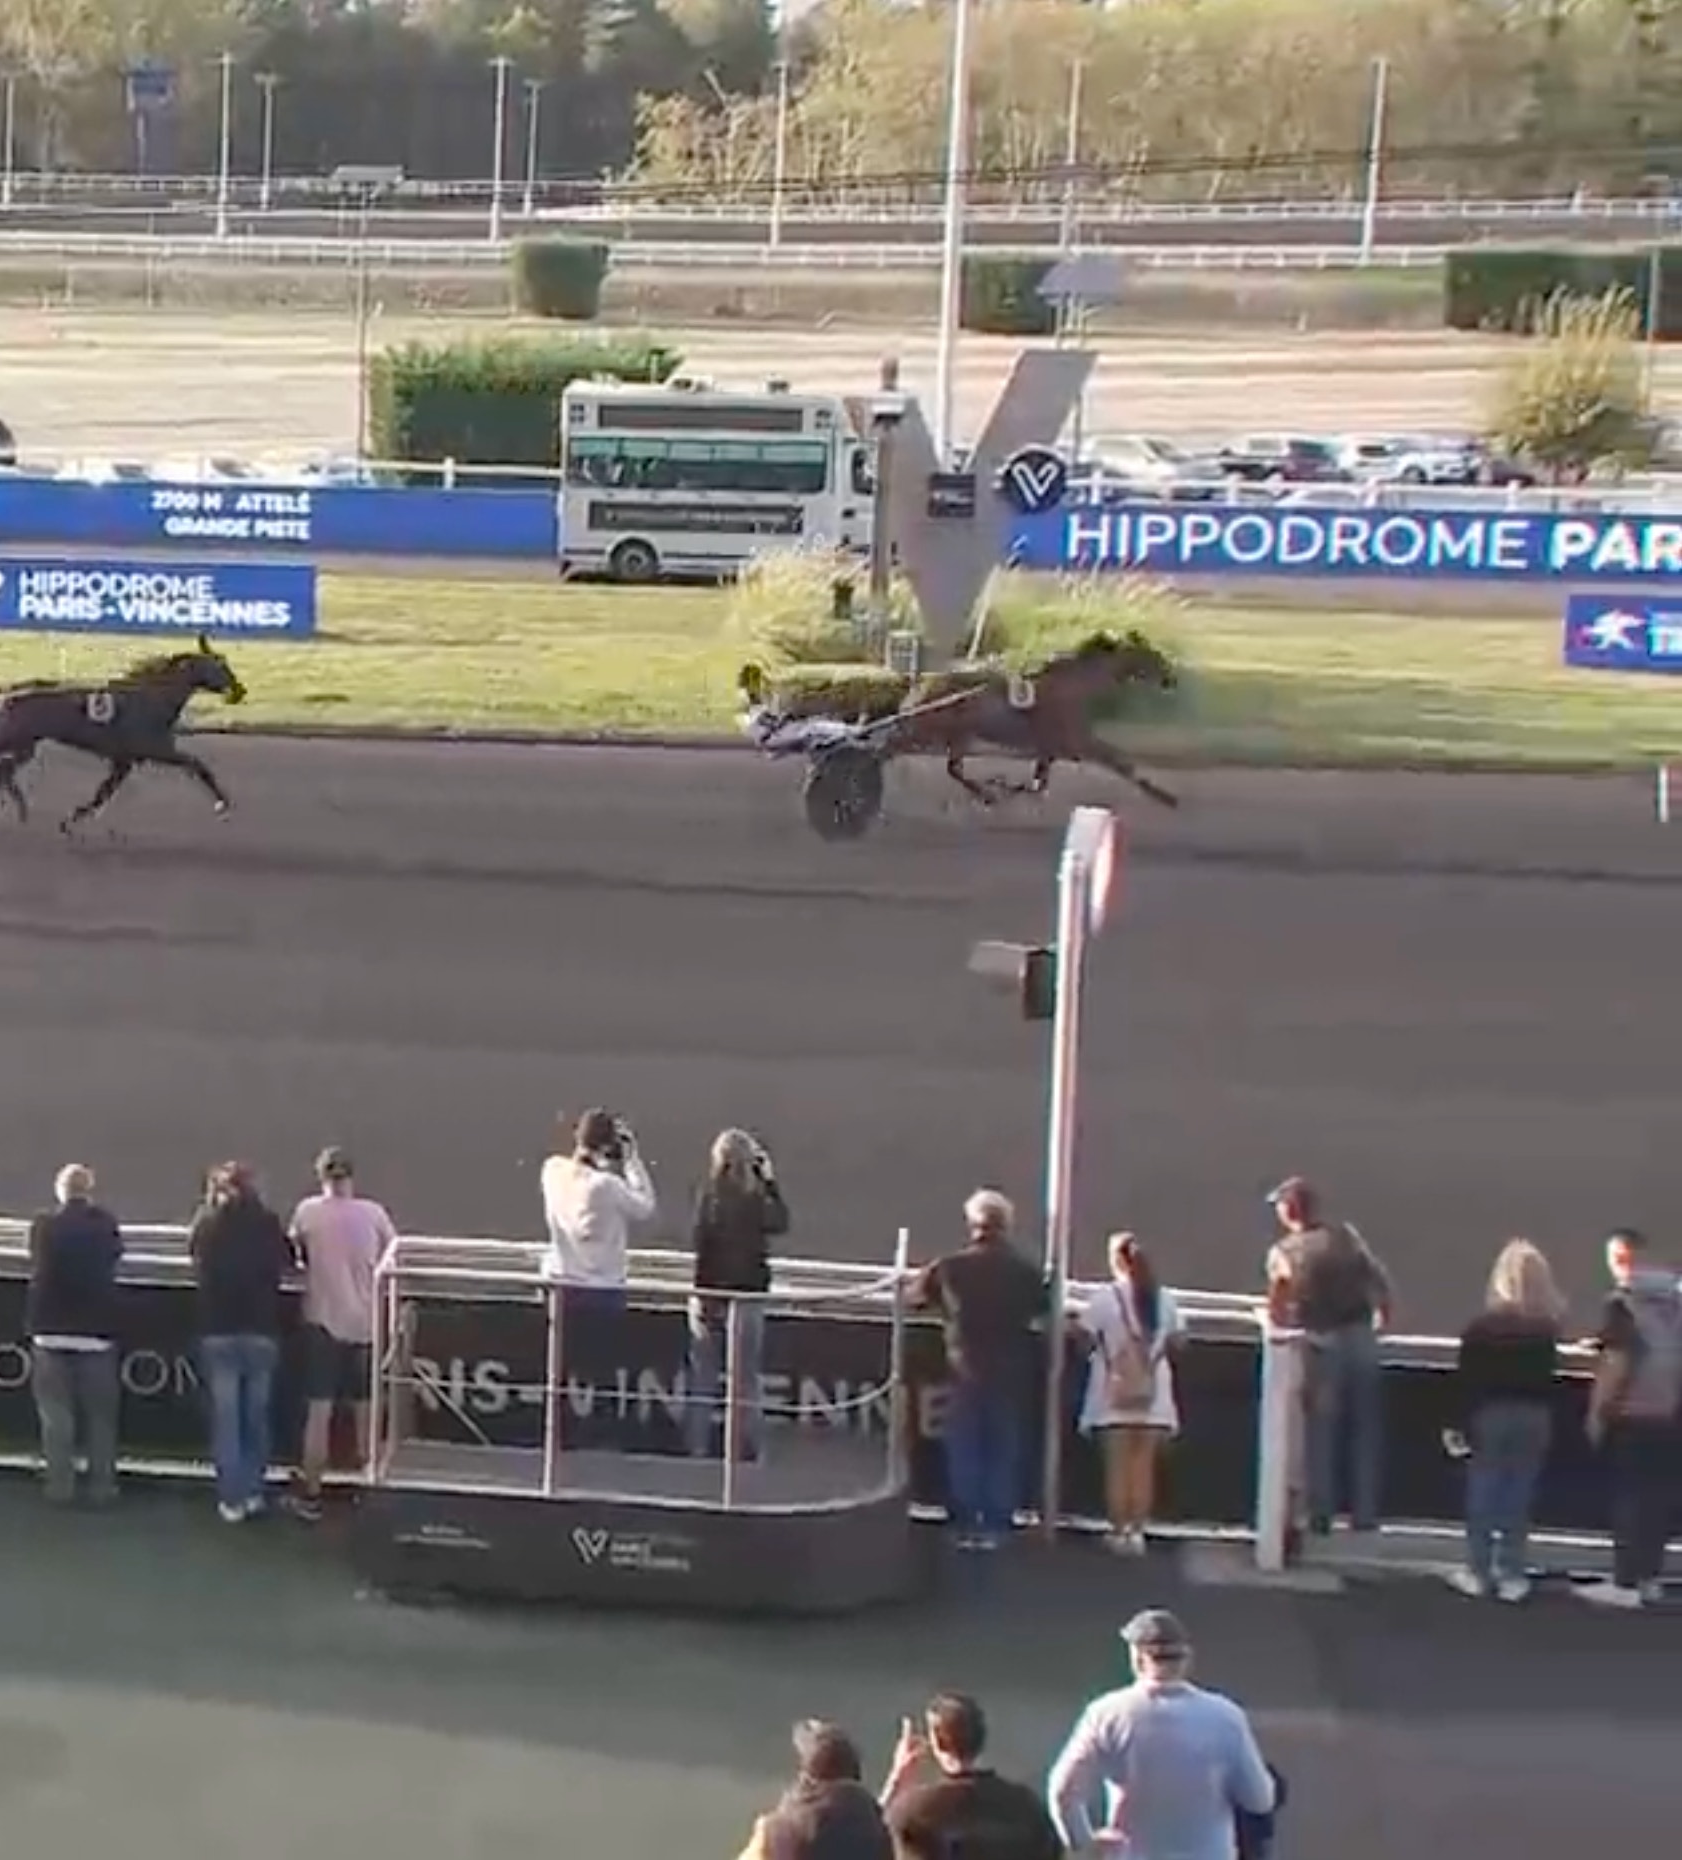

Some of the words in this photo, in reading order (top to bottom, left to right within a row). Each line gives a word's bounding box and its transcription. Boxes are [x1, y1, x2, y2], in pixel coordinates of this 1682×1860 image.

[150, 489, 200, 510] 2700
[203, 491, 223, 511] M
[164, 516, 250, 537] GRANDE
[1066, 512, 1530, 569] HIPPODROME
[1549, 521, 1682, 571] PAR
[18, 570, 215, 600] HIPPODROME
